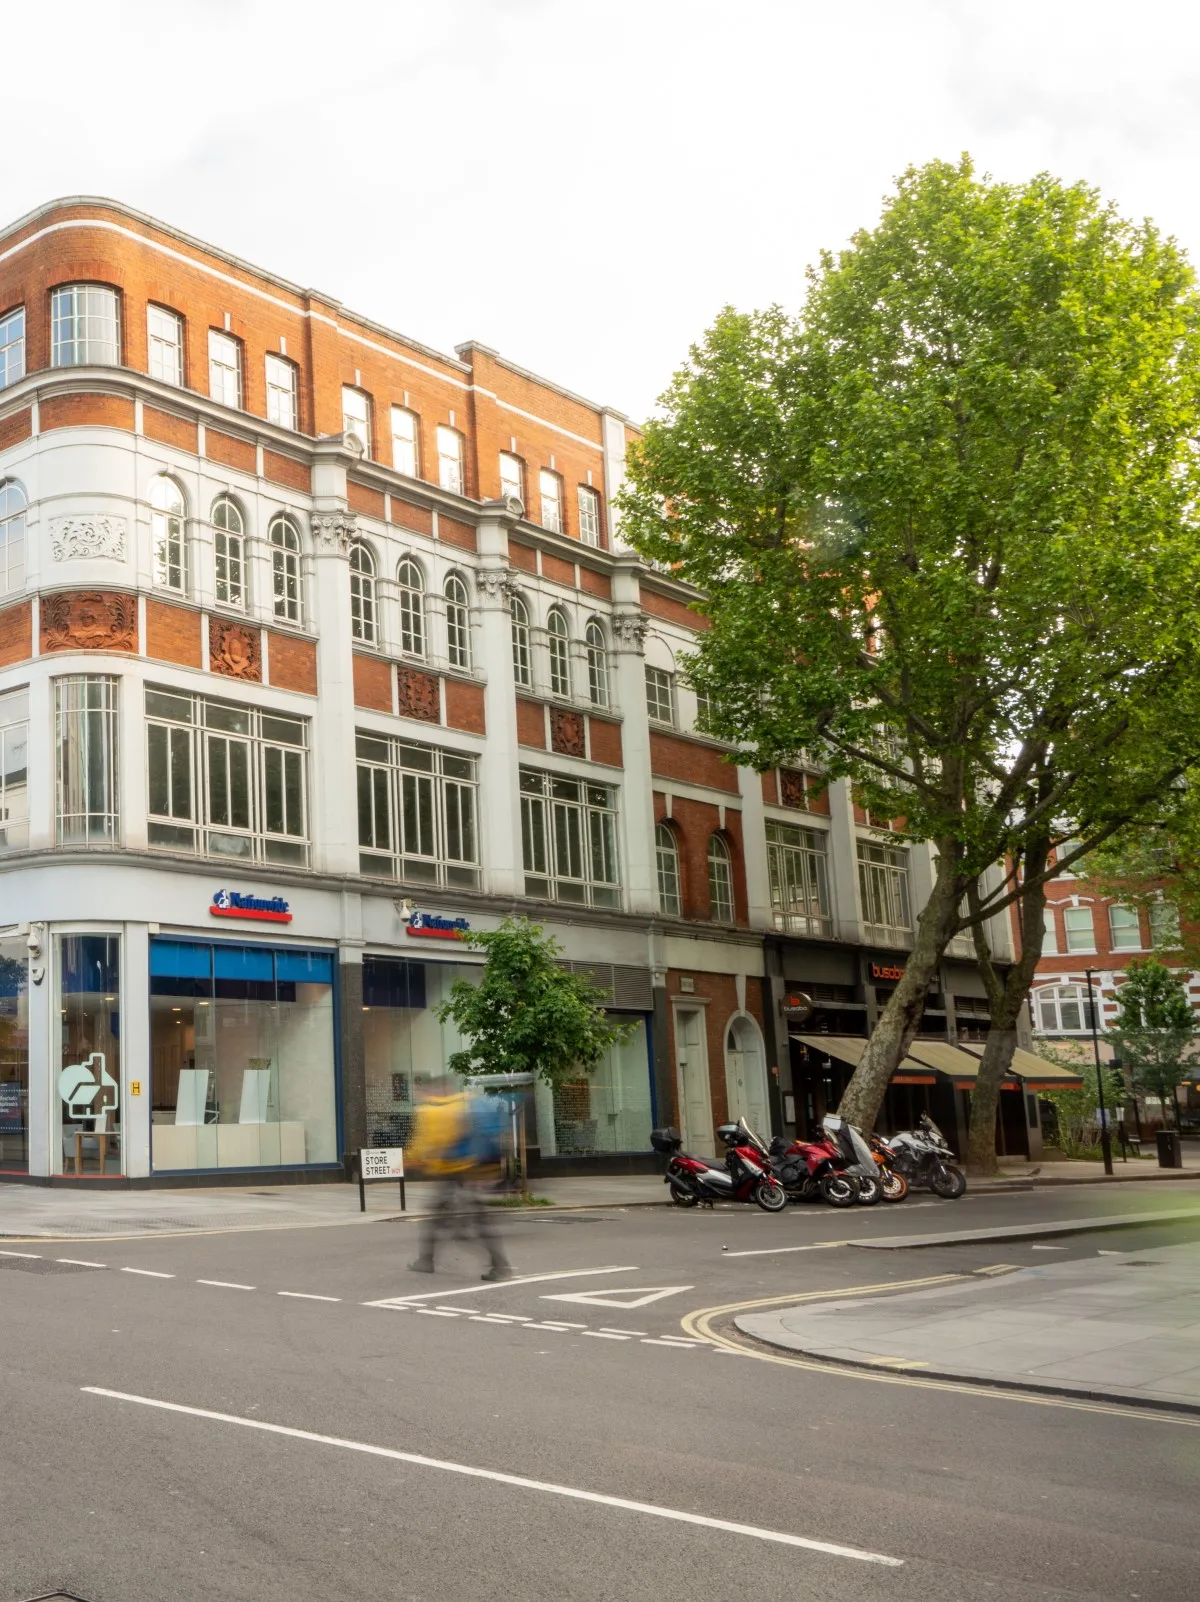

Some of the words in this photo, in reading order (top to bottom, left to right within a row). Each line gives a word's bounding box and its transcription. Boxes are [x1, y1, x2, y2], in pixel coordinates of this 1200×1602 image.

[230, 892, 289, 914] Nationwide
[422, 914, 470, 930] Nationwide
[132, 1082, 140, 1094] H
[365, 1156, 388, 1165] STORE
[365, 1166, 390, 1175] STREET
